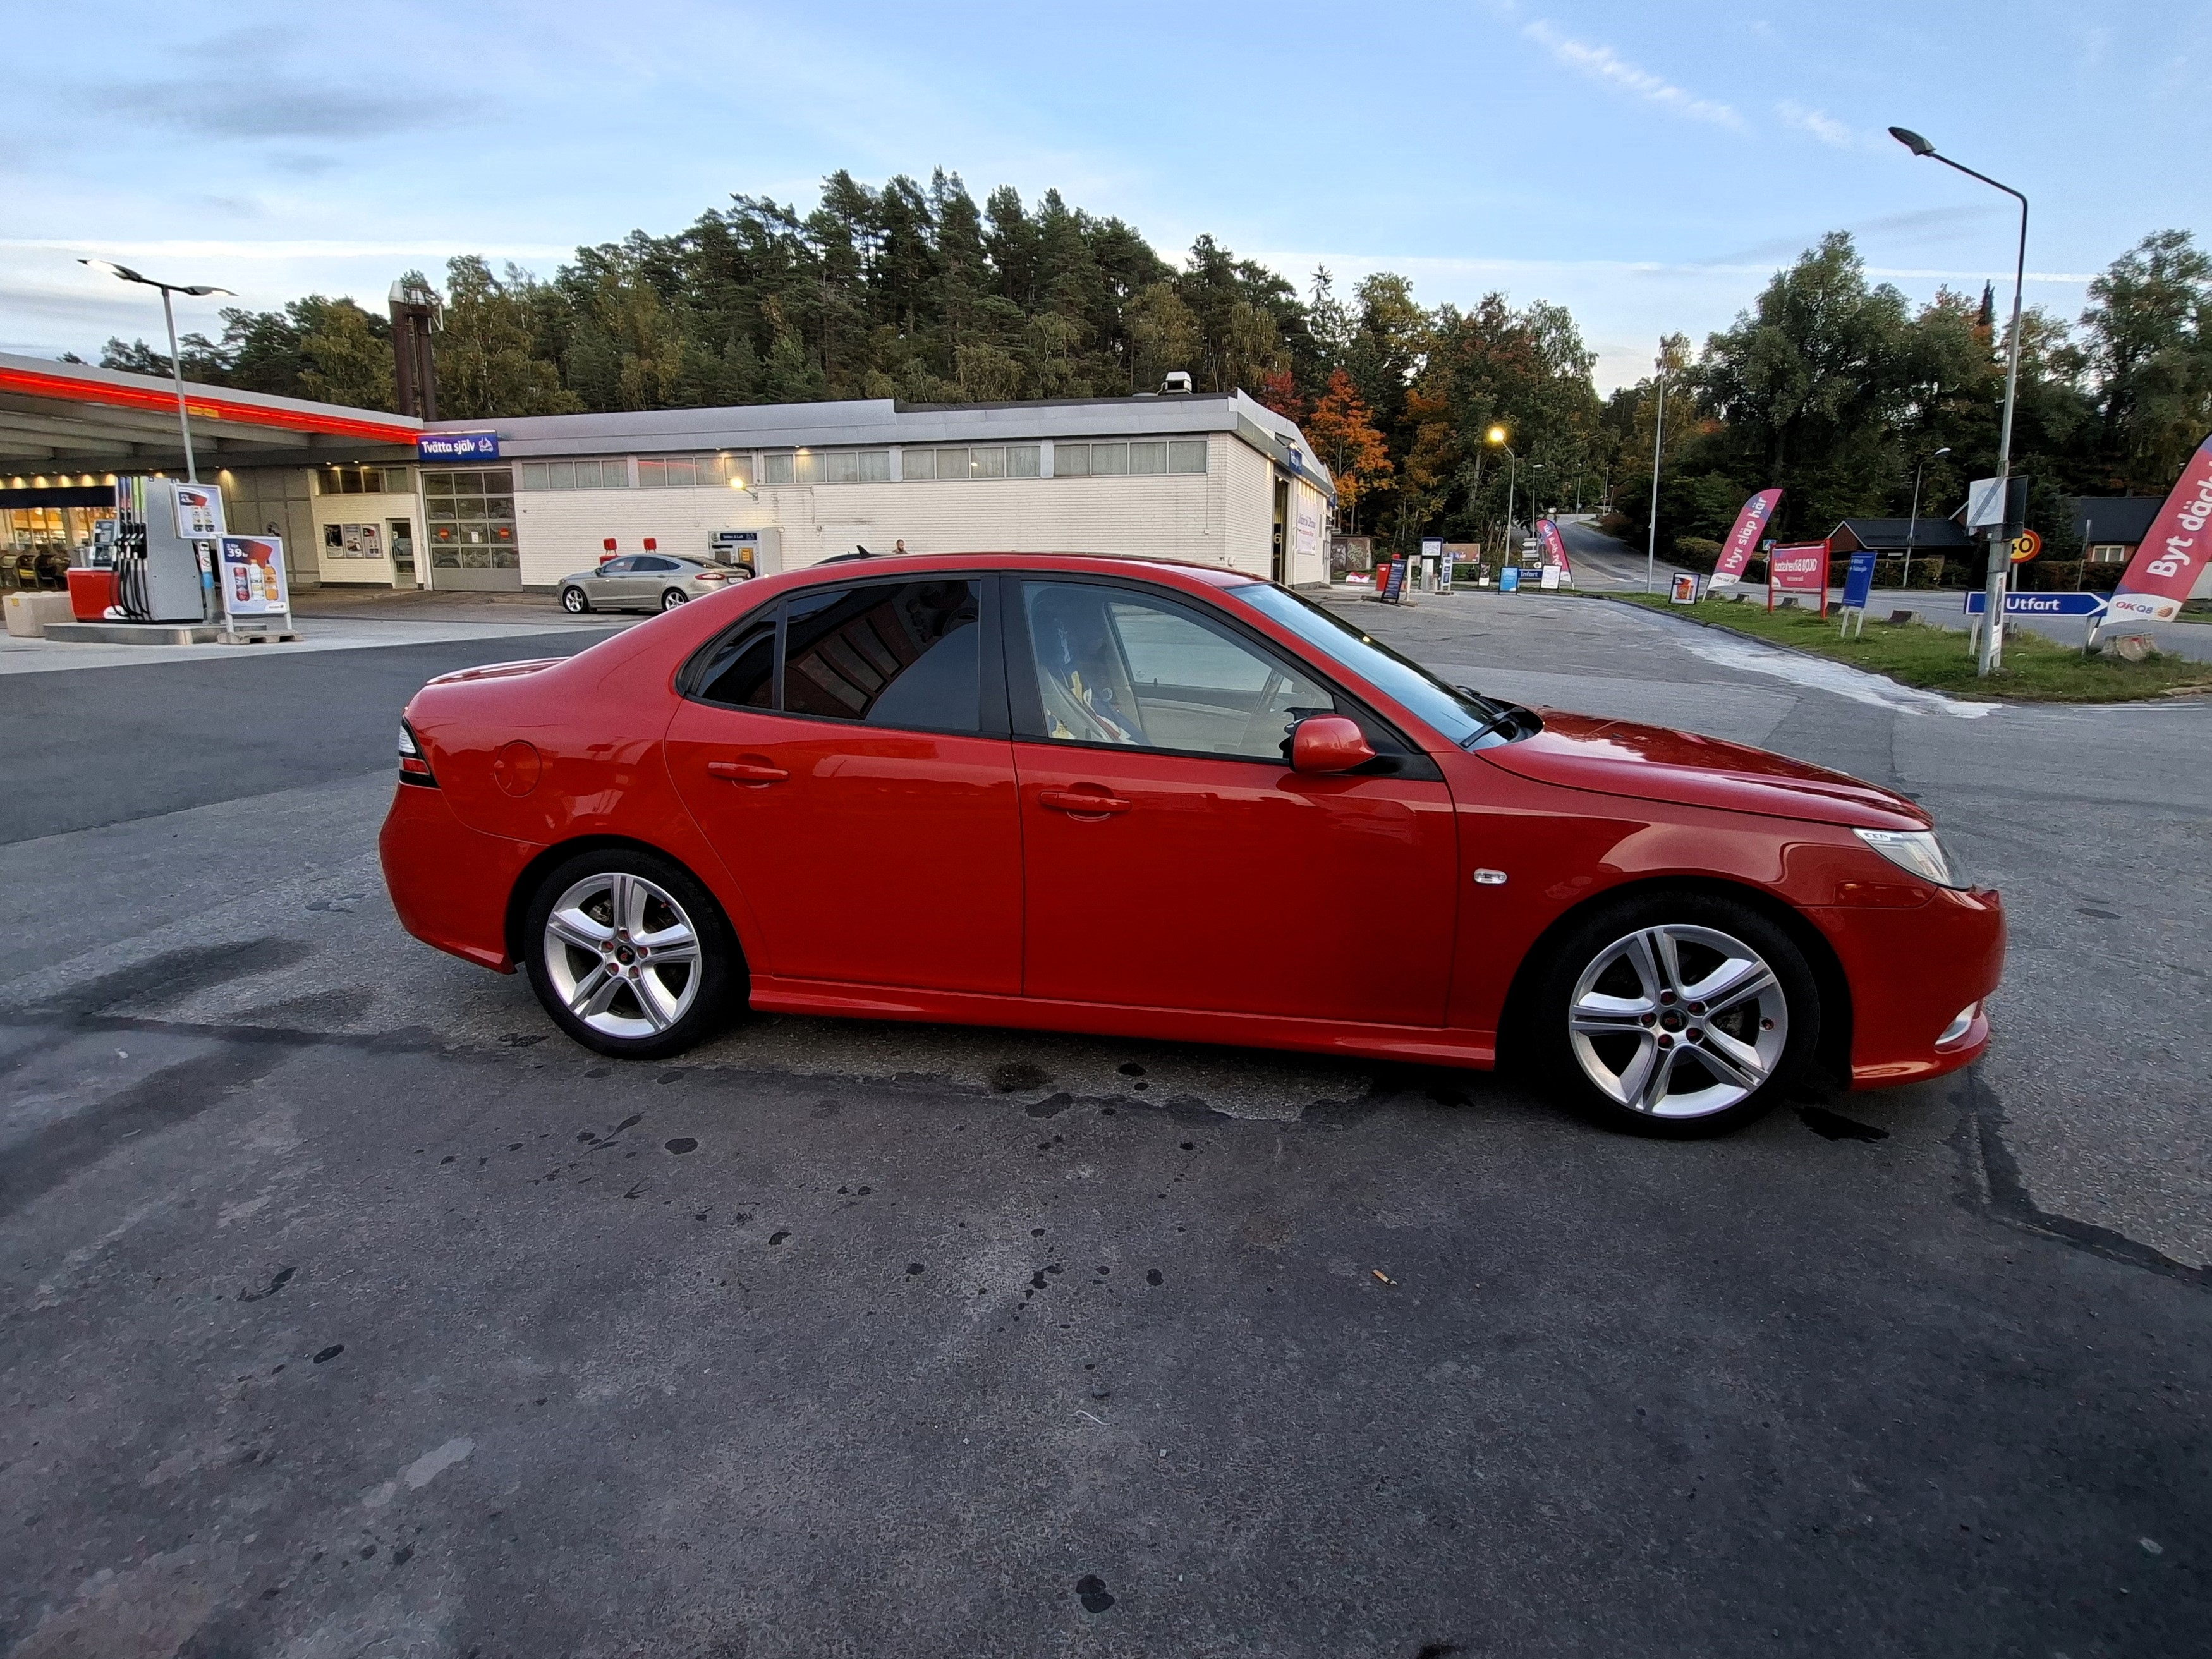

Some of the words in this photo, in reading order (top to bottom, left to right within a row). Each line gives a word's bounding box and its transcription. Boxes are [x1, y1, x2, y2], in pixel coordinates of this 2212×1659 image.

[421, 441, 453, 453] Tvätta
[454, 439, 475, 455] själv
[1747, 496, 1768, 518] här
[1737, 520, 1758, 546] släp
[227, 547, 242, 557] 39
[1724, 546, 1744, 569] Hyr
[2146, 535, 2194, 578] Byt
[2006, 597, 2061, 611] Utfart
[2115, 601, 2154, 614] OKQ8
